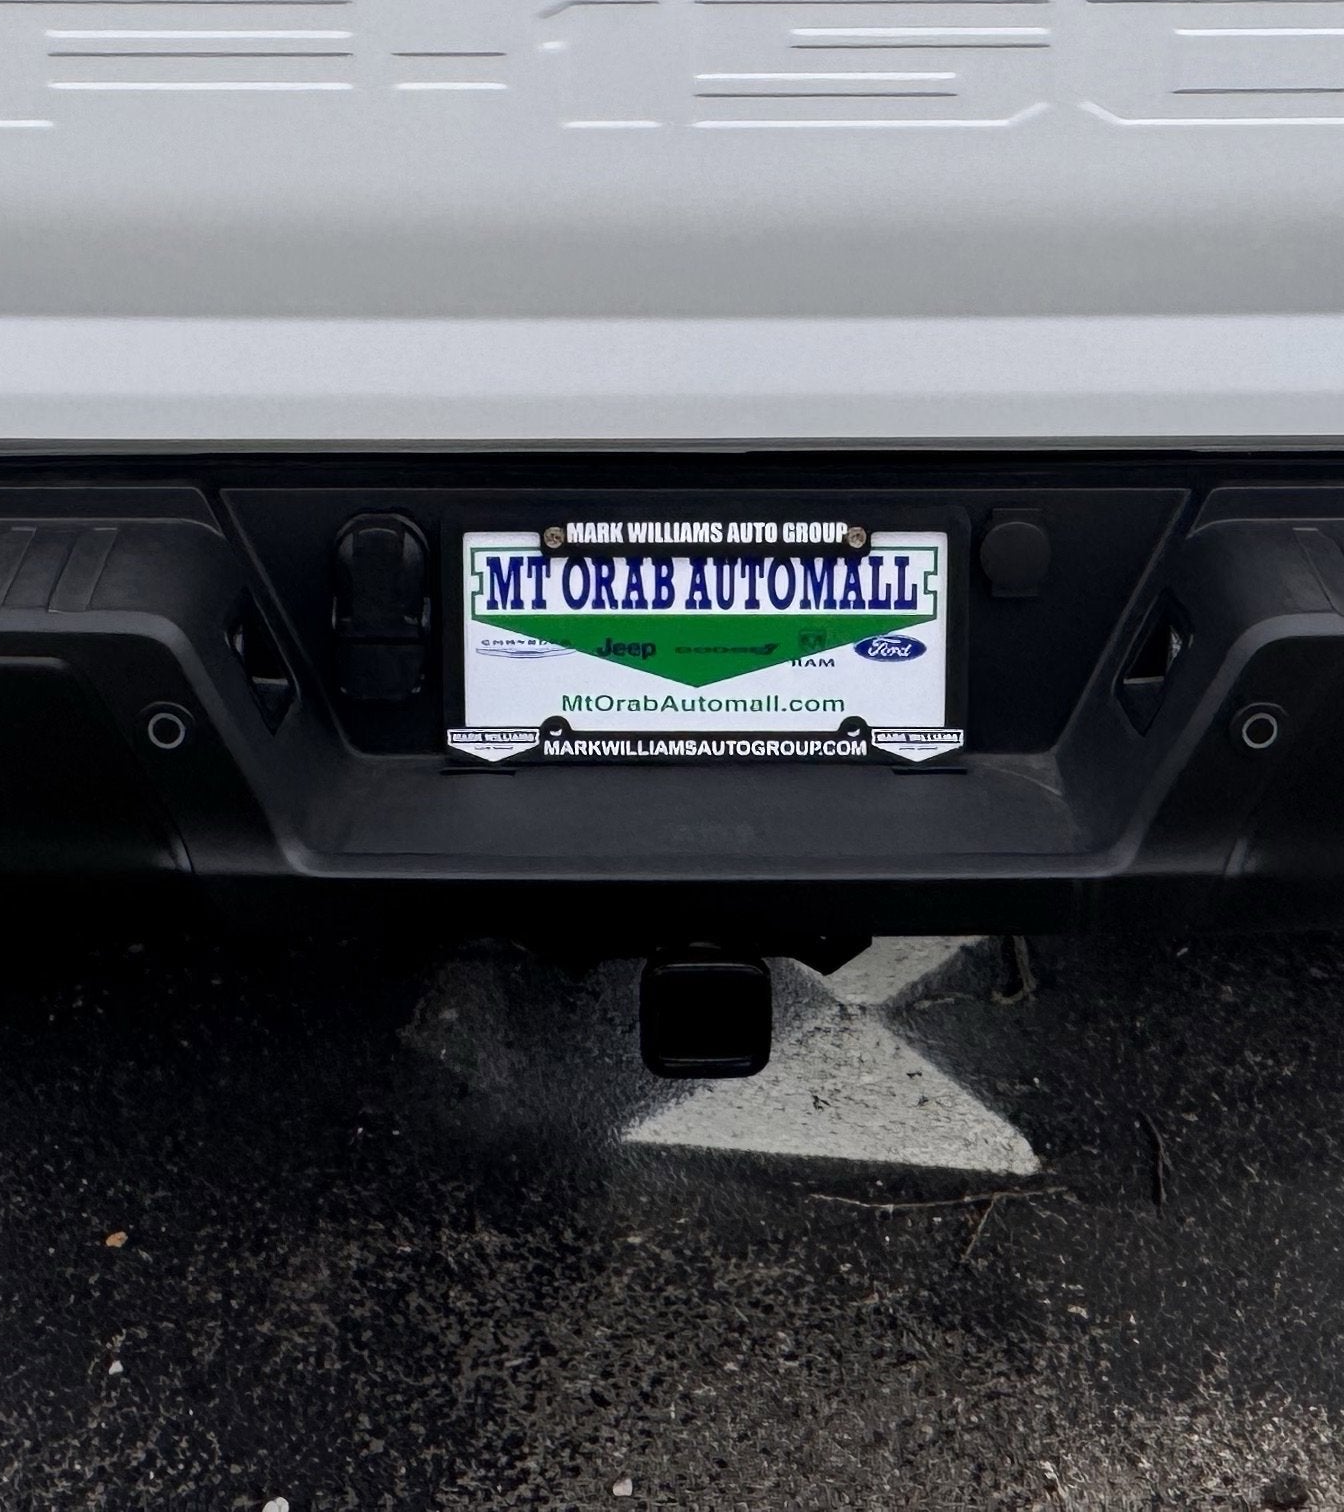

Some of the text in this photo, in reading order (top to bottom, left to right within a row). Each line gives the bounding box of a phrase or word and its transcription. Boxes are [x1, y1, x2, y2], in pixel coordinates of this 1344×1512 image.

[566, 522, 849, 544] MARK WILLIAMS AUTO GROUP
[486, 555, 919, 611] MT ORAB AUTOMALL
[596, 637, 657, 660] Jeep
[867, 637, 913, 657] Ford
[791, 657, 836, 668] RAM
[561, 694, 845, 713] MtOrabAutomall.com
[543, 739, 868, 757] MARKWILLIAMSAUTOGROUP.COM
